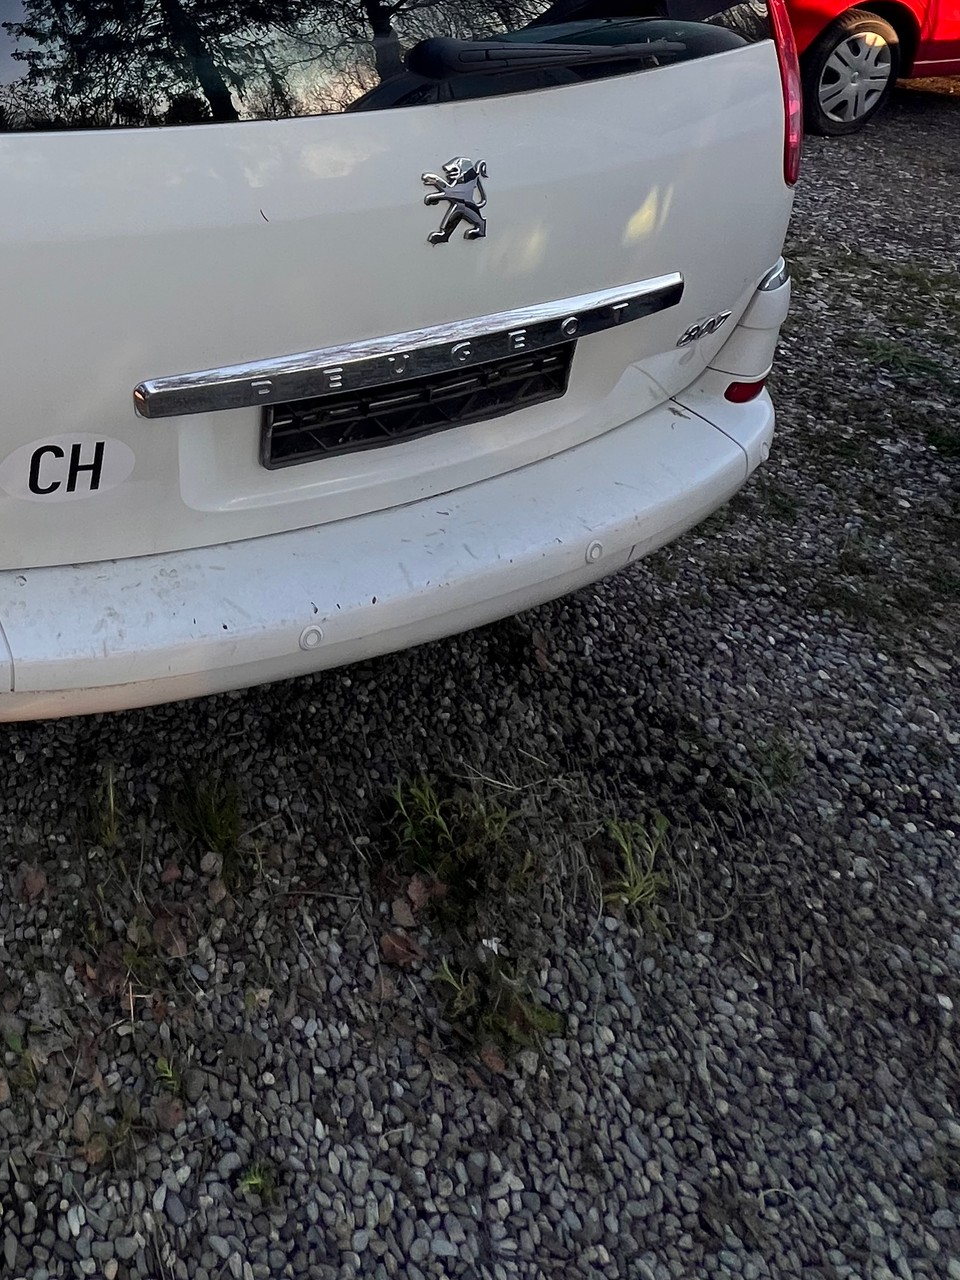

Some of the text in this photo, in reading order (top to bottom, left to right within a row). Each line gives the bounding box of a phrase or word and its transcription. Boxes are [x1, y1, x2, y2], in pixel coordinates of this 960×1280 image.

[250, 302, 630, 395] PEUGEOT
[675, 309, 733, 348] 807
[28, 441, 106, 495] CH
